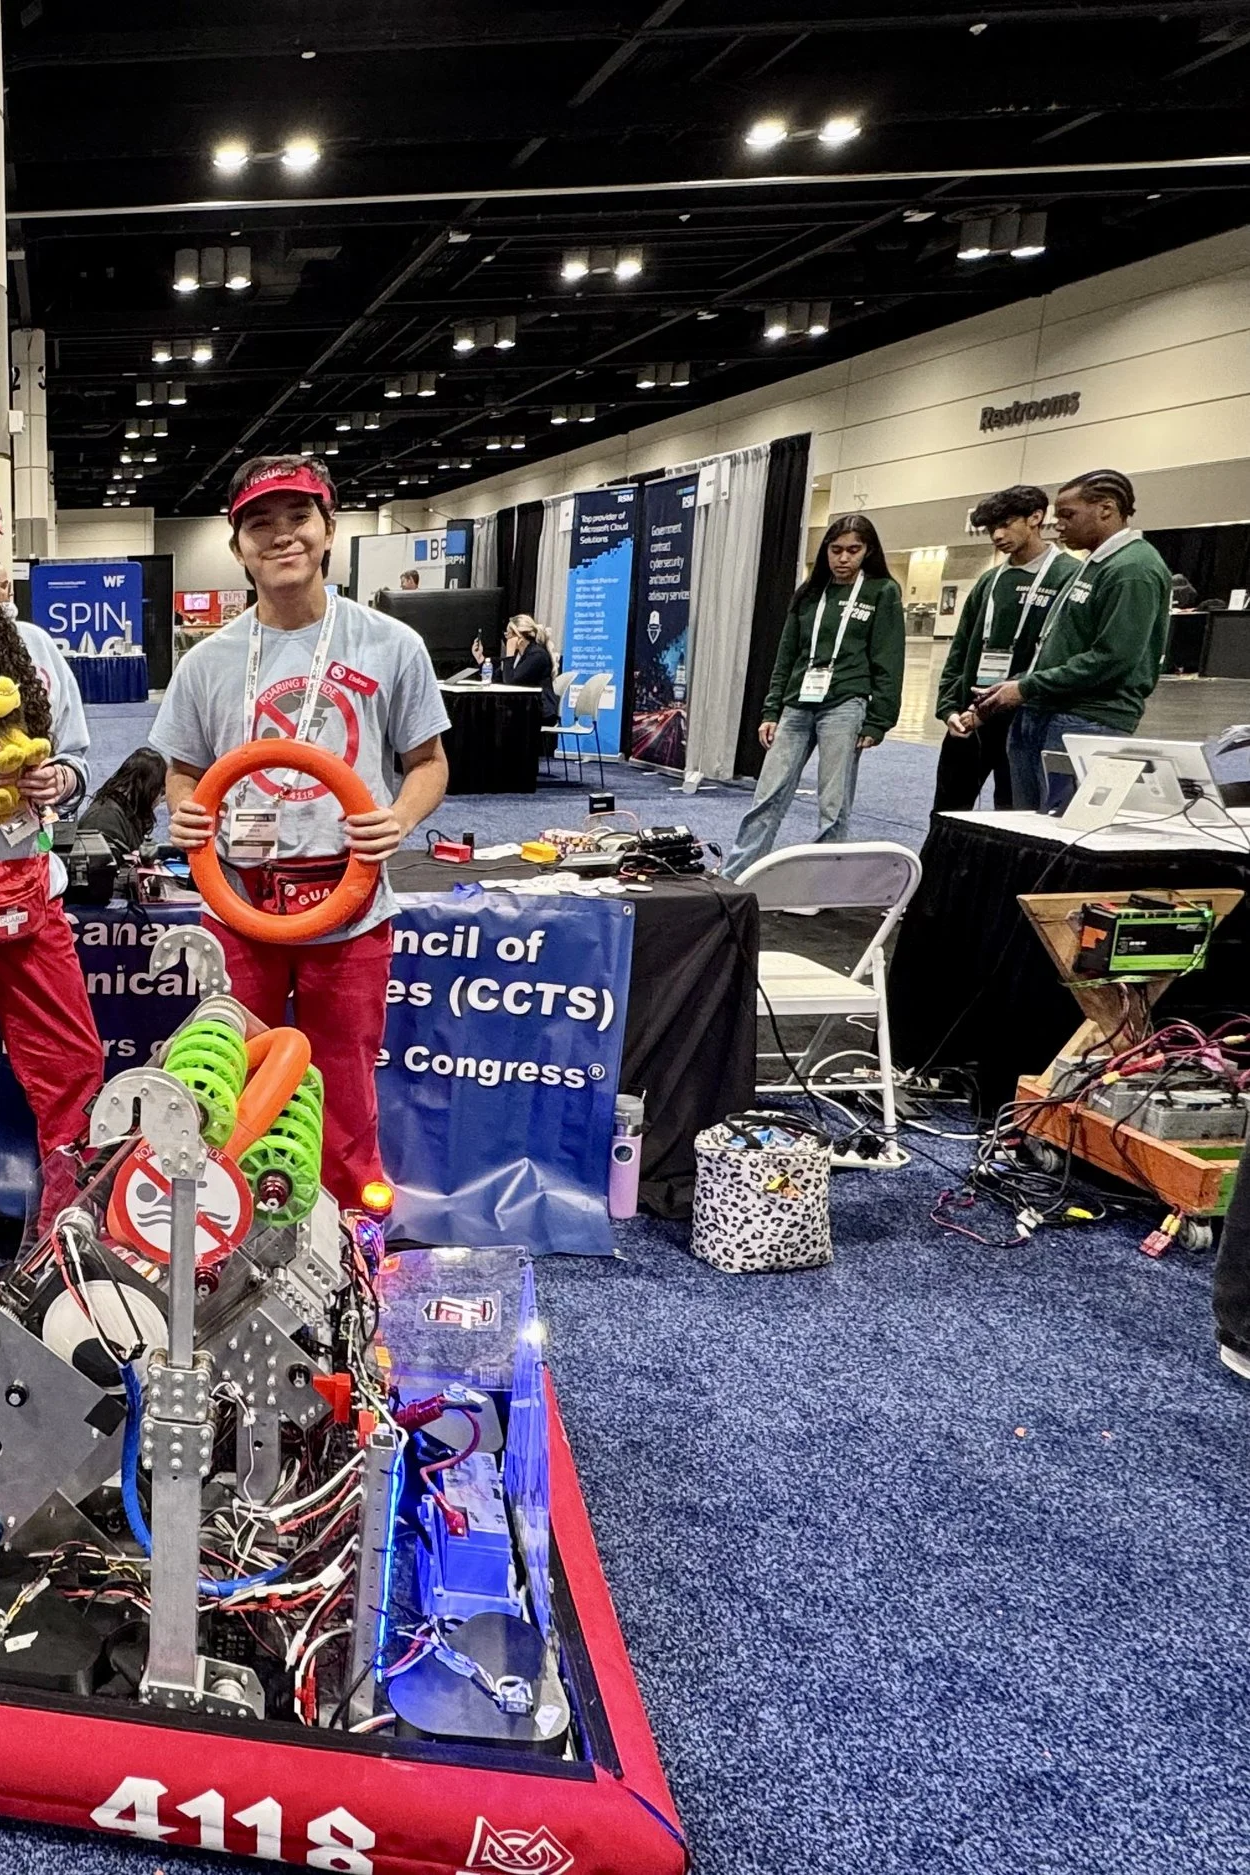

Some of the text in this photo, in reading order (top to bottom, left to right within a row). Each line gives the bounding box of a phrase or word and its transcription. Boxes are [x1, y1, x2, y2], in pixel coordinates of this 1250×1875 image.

[980, 391, 1081, 432] Restrooms
[617, 493, 634, 503] RSM
[581, 510, 627, 524] Top provider of
[580, 522, 629, 534] Microsoft Cloud
[651, 523, 683, 537] Government
[579, 536, 609, 545] Solutions
[649, 556, 685, 571] cybersecurity
[103, 575, 126, 588] WF
[48, 601, 126, 633] SPIN
[259, 679, 300, 706] ROARING
[289, 789, 315, 801] 4118
[297, 887, 332, 906] GUA
[393, 925, 480, 958] ncil
[496, 930, 546, 963] of
[86, 964, 198, 996] nical
[449, 975, 615, 1032] (CCTS)
[89, 1775, 376, 1874] 4118
